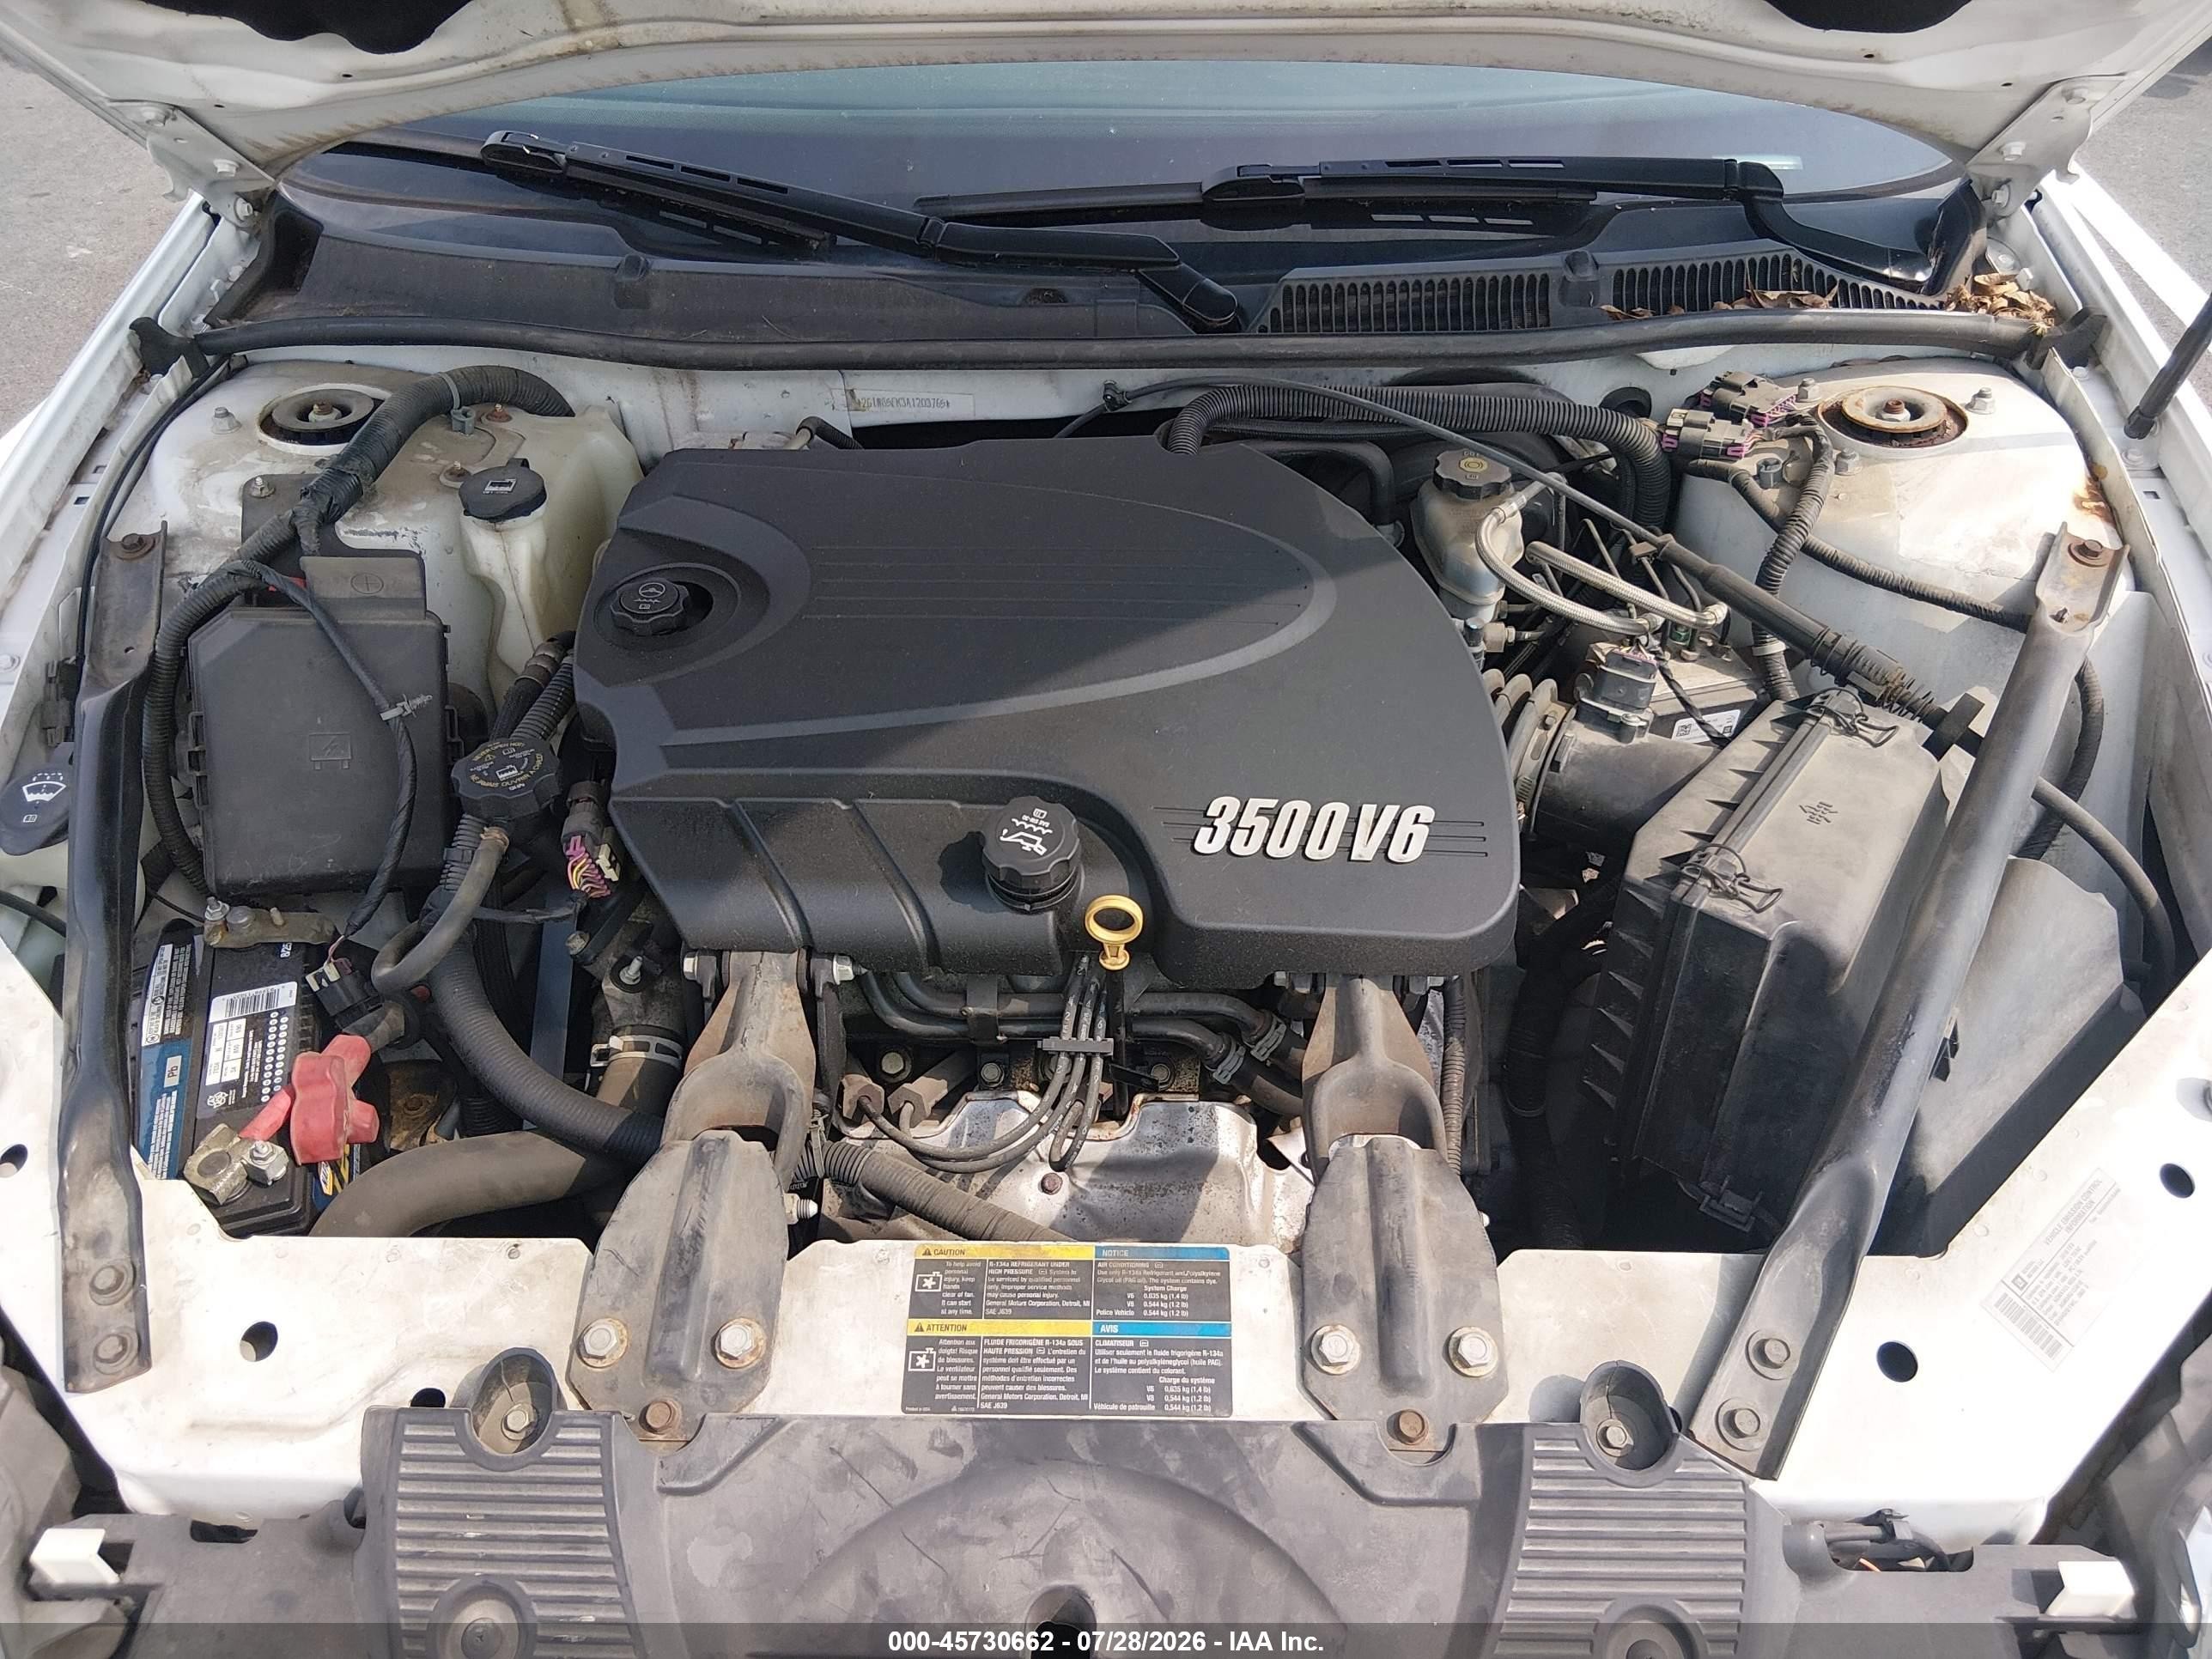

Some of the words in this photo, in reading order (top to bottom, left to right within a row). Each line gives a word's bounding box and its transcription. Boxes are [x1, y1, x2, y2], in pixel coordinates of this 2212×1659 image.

[1193, 795, 1351, 861] 3500
[1350, 803, 1437, 864] V6
[167, 1065, 179, 1079] Pb
[1100, 1324, 1119, 1333] AVIS
